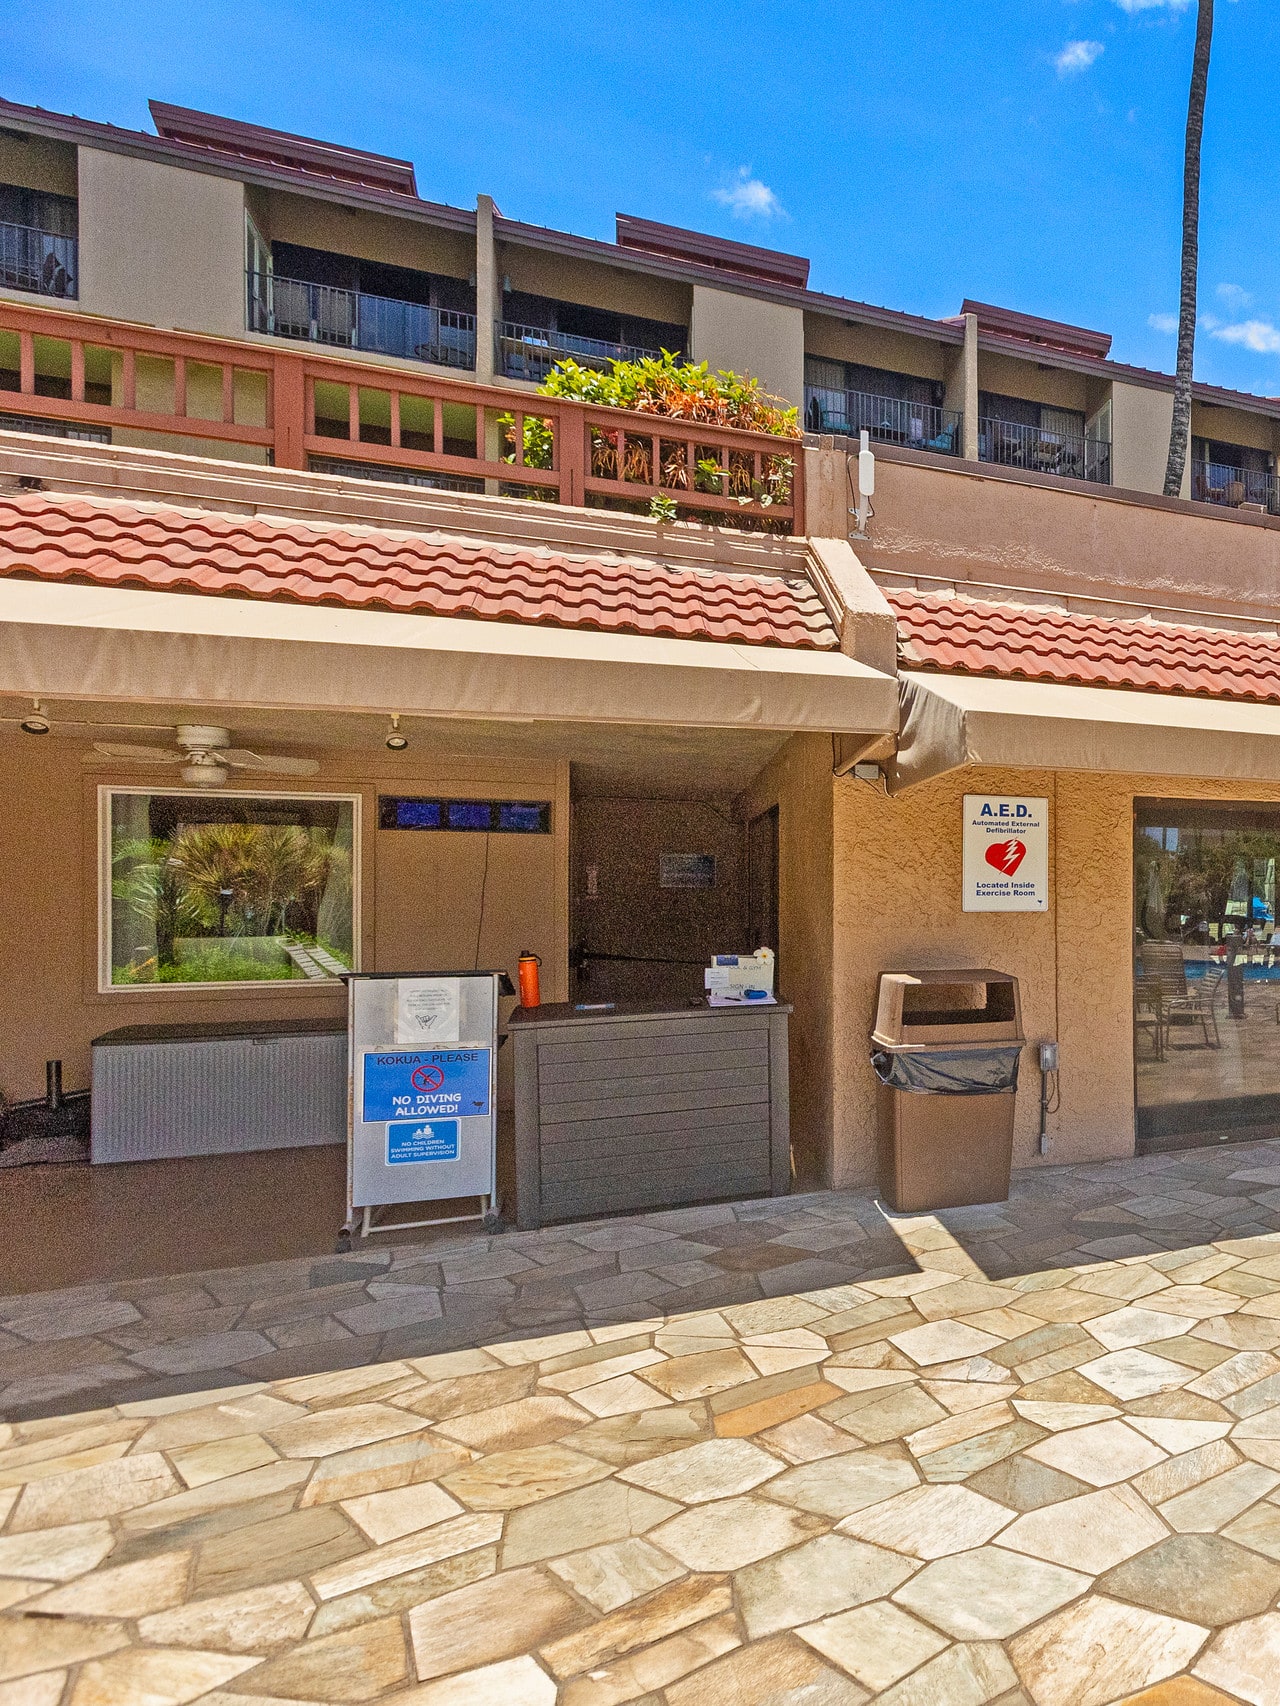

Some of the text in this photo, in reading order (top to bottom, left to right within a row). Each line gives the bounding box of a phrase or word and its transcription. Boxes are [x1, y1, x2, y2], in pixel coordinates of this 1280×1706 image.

[980, 803, 1032, 818] A.E.D.
[376, 1055, 421, 1065] KOKUA
[431, 1053, 478, 1063] PLEASE
[392, 1093, 462, 1106] NO DIVING
[395, 1104, 459, 1116] ALLOWED!
